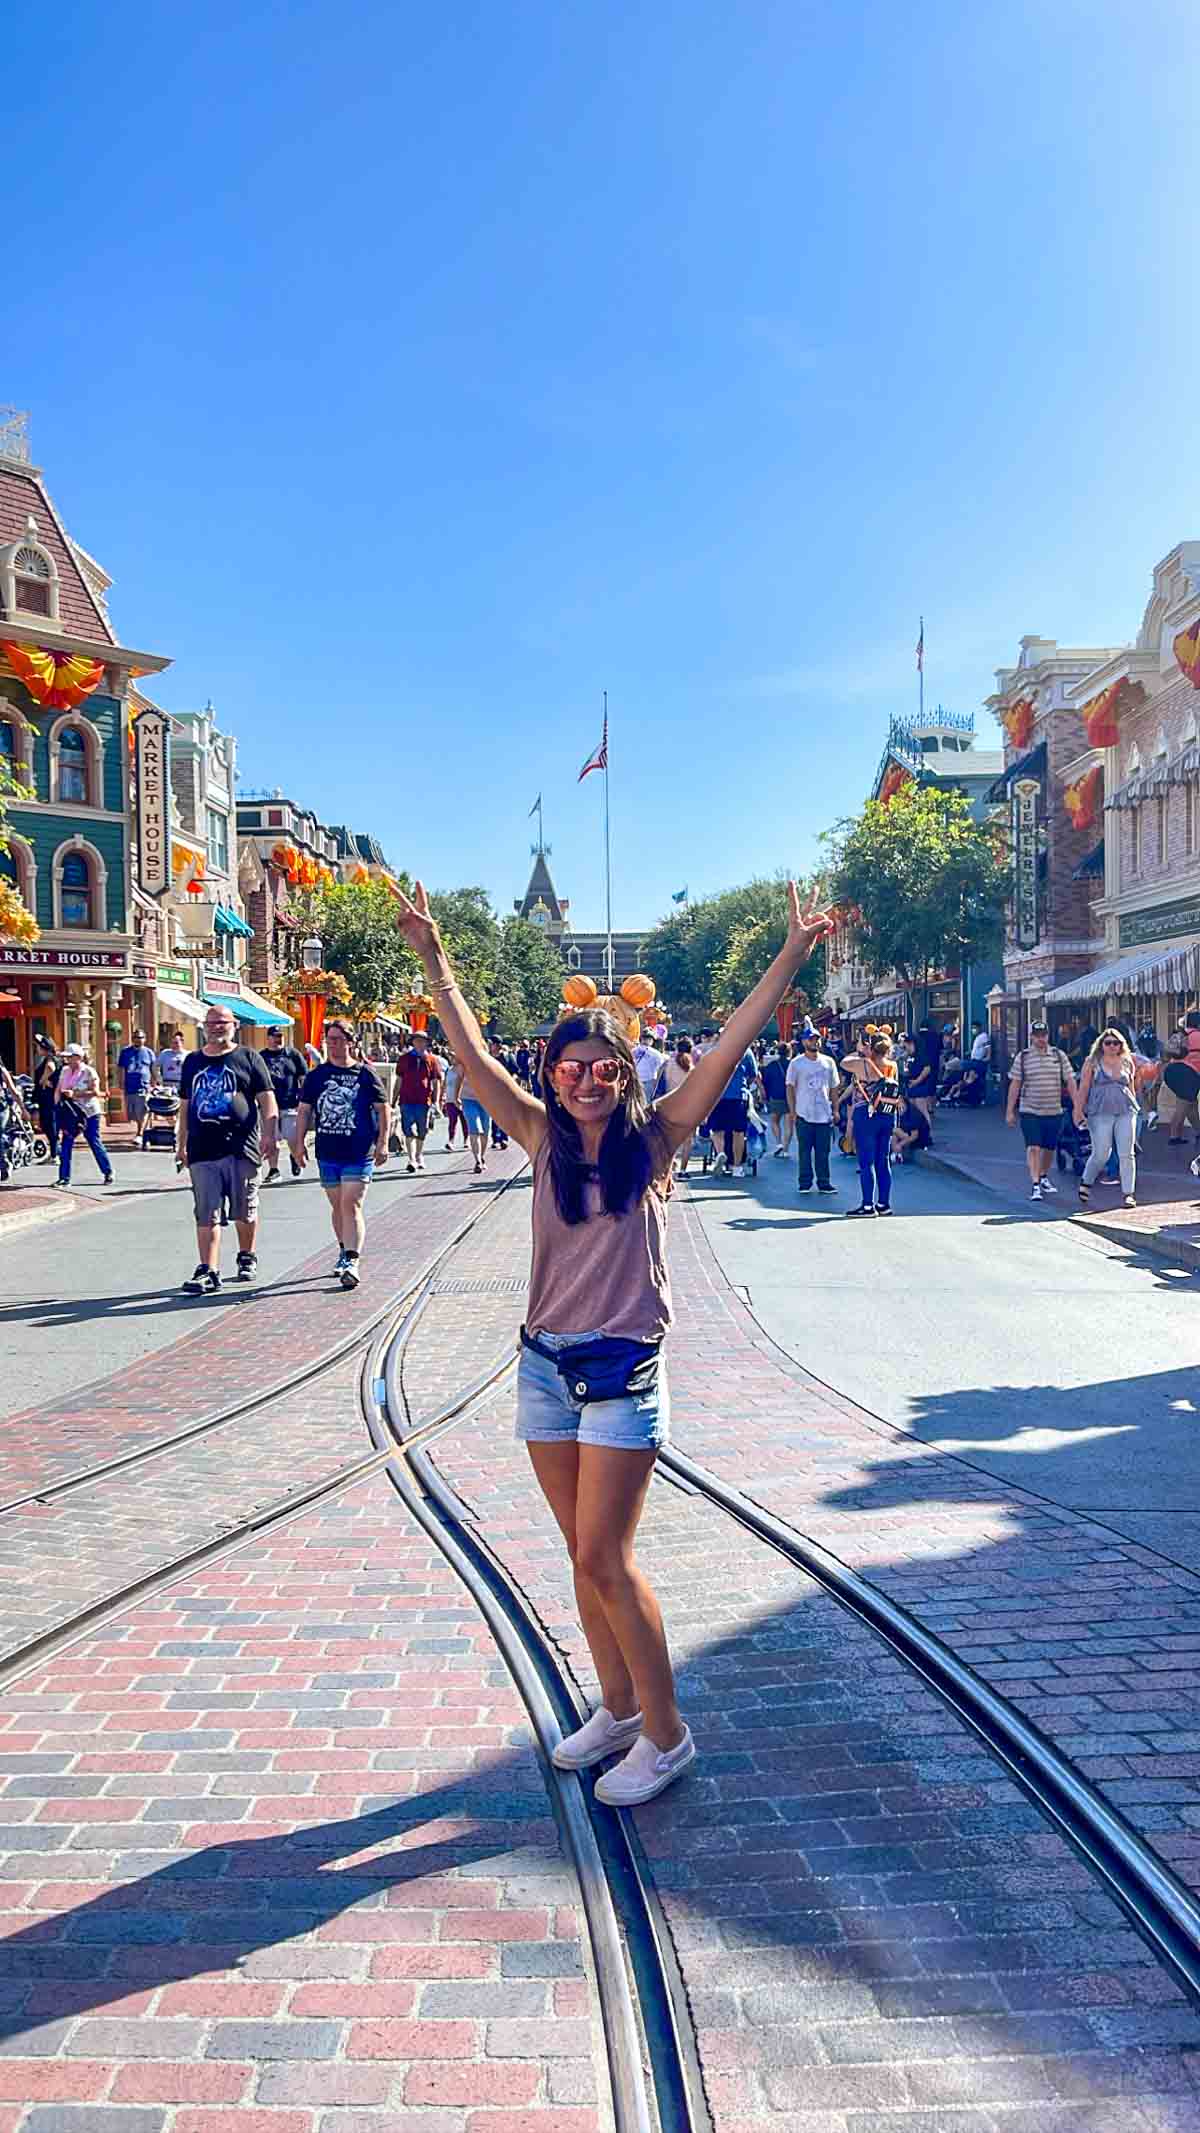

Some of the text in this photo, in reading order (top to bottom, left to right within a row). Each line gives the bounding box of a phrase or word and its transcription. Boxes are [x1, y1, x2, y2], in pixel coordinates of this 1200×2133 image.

[142, 724, 160, 881] MARKET HOUSE
[0, 950, 110, 965] RKET HOUSE
